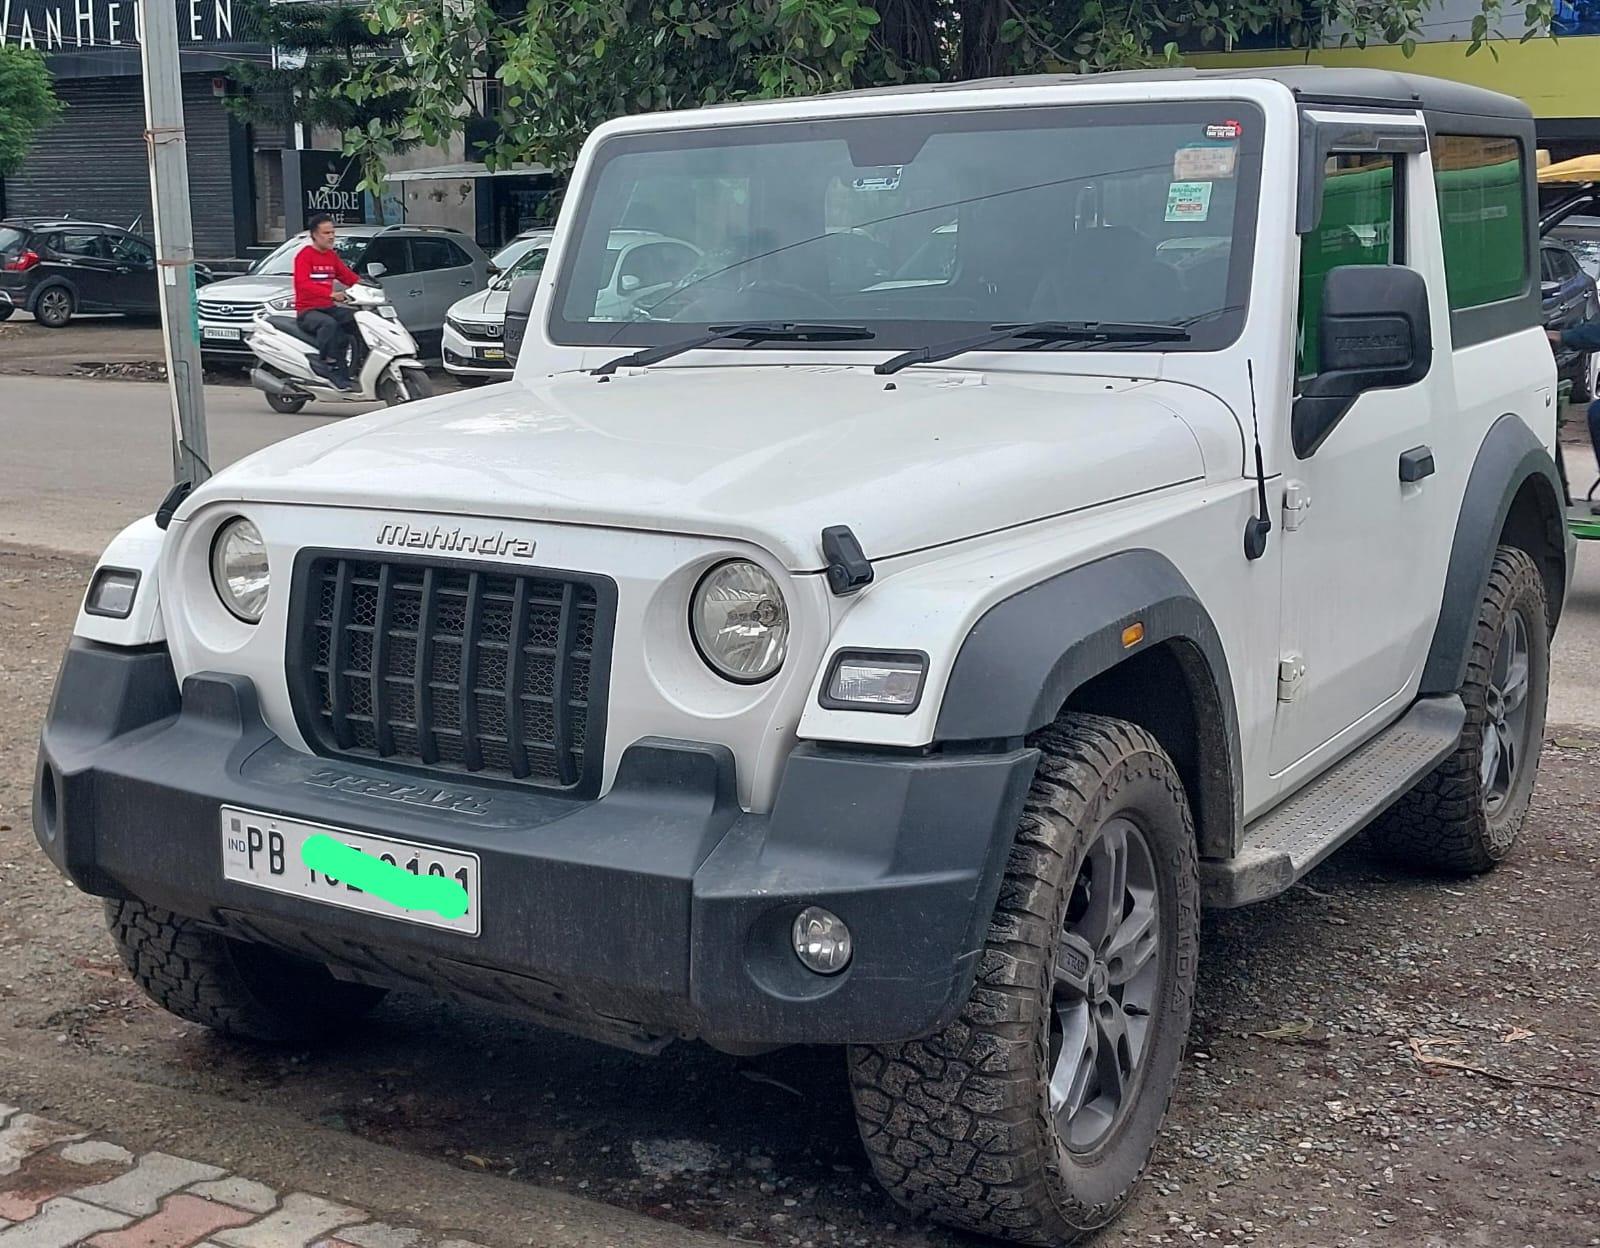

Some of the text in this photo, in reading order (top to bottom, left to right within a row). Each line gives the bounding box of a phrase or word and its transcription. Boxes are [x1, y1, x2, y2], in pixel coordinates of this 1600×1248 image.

[74, 0, 232, 47] HEEN
[306, 189, 360, 210] MADRE
[325, 210, 345, 225] AFÉ
[376, 522, 537, 558] Mahindra
[228, 826, 286, 876] IND PB
